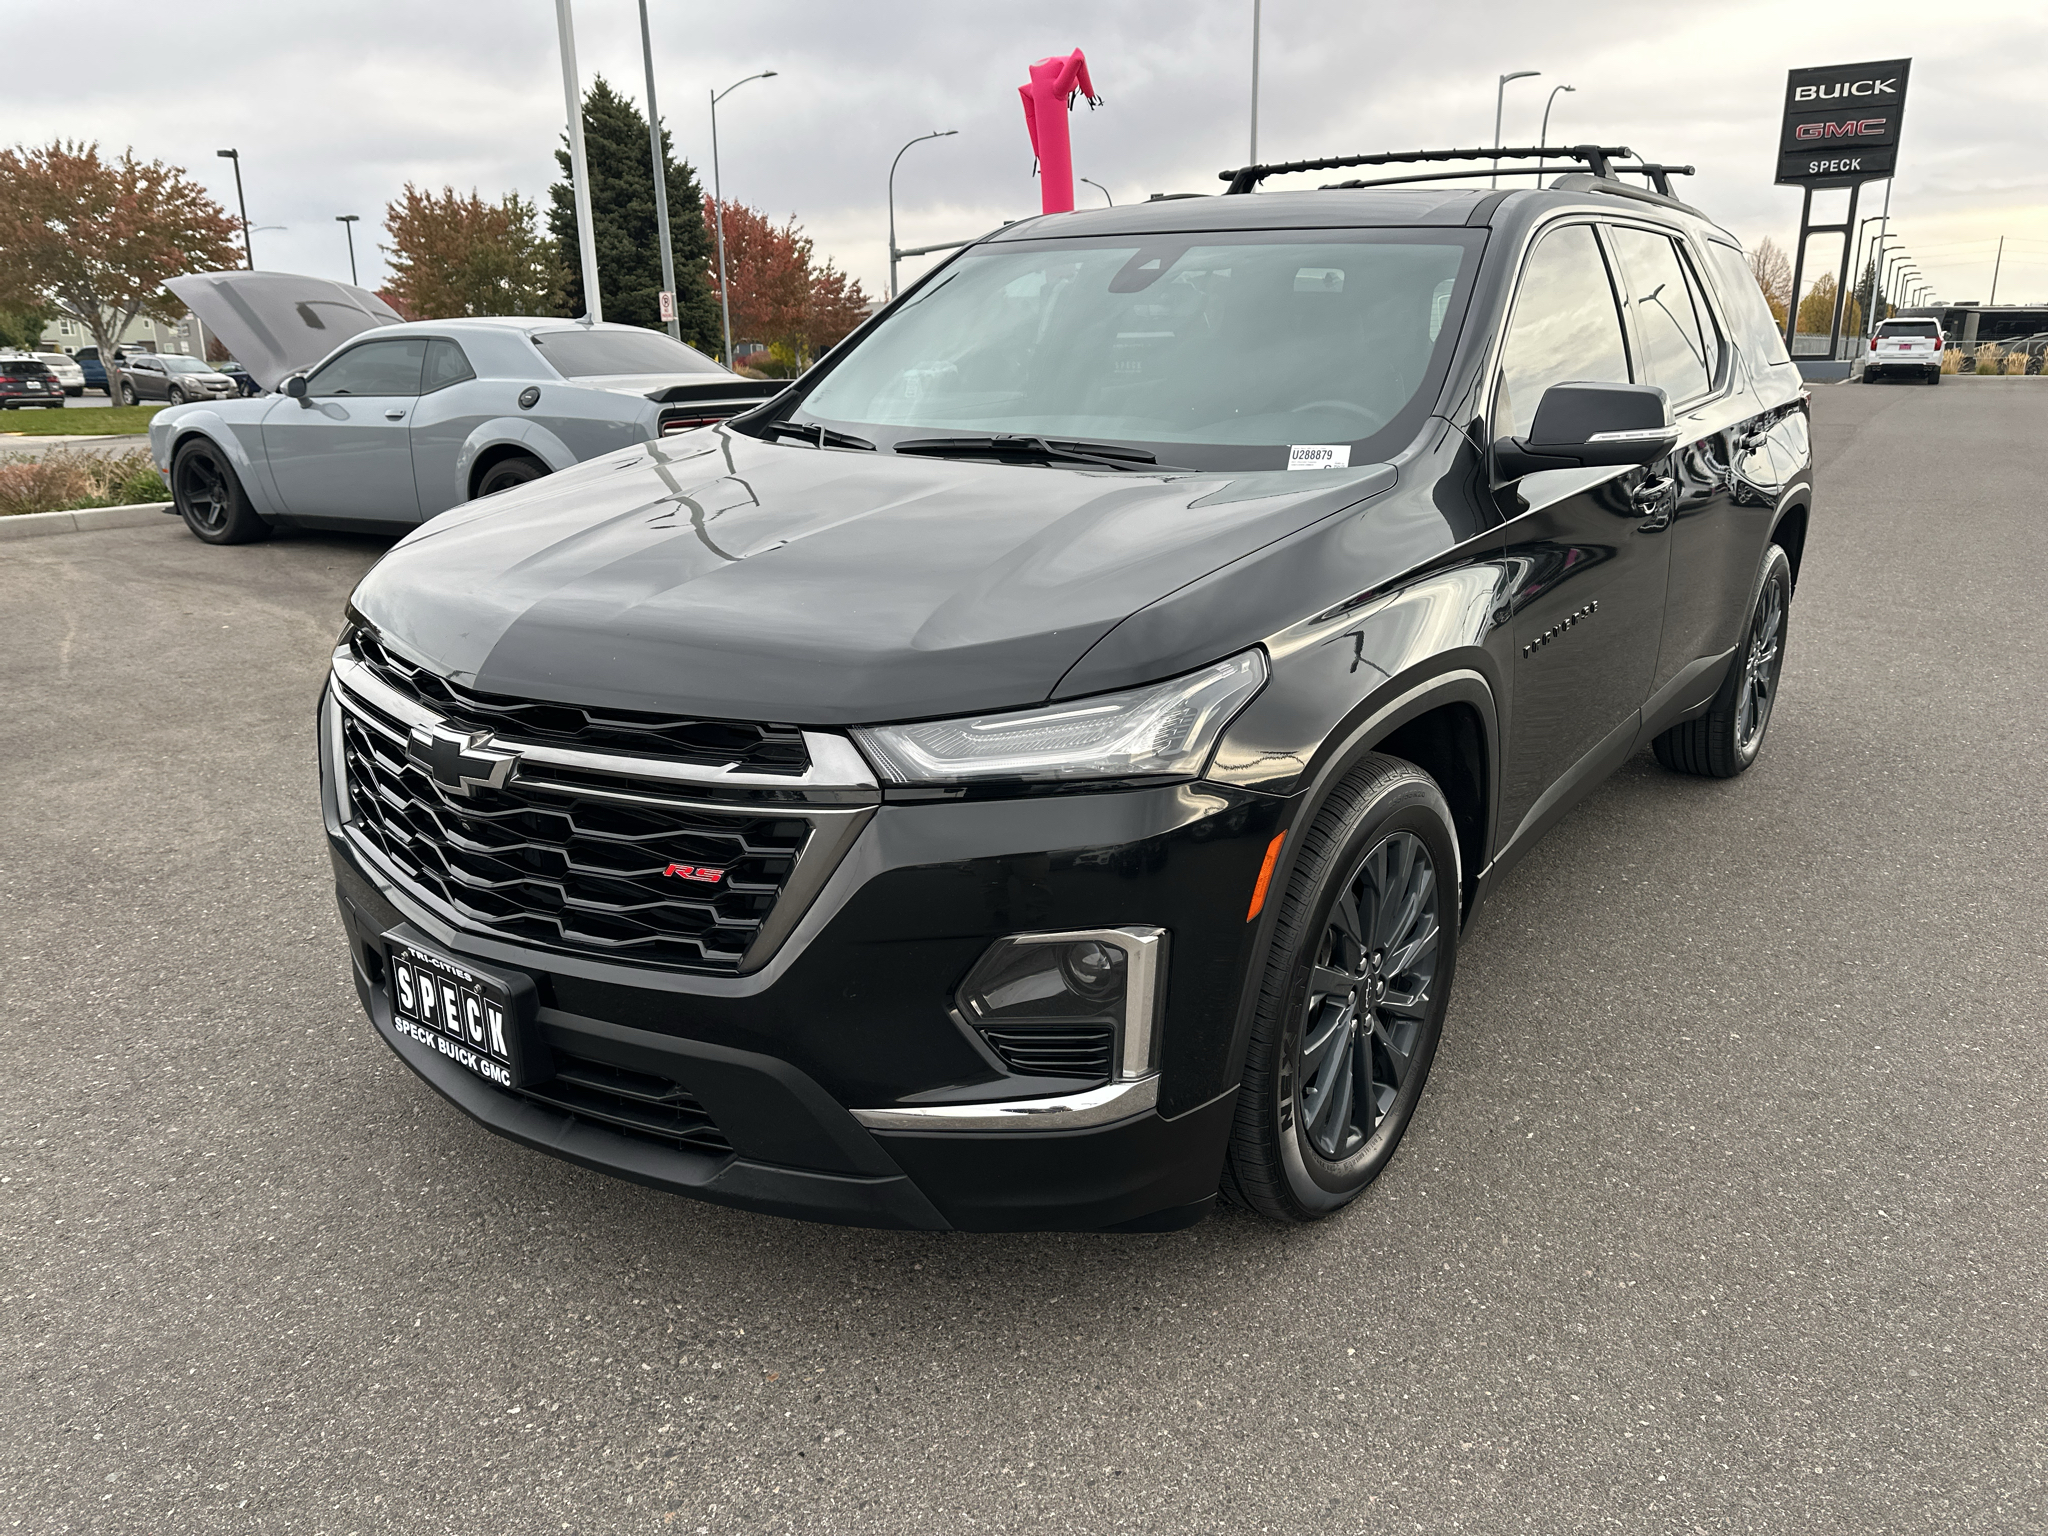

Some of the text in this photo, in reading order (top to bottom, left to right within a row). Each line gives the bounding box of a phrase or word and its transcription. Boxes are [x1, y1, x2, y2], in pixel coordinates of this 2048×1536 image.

[1795, 78, 1897, 101] BUICK
[1796, 118, 1886, 140] GMC
[1809, 158, 1861, 173] SPECK
[1292, 450, 1333, 460] U288879
[663, 863, 725, 883] RS
[408, 947, 473, 982] TRI-CITIES
[397, 966, 508, 1057] SPECK
[394, 1017, 511, 1087] SPECK BUICK GMC
[1280, 965, 1311, 1133] NEXEN
